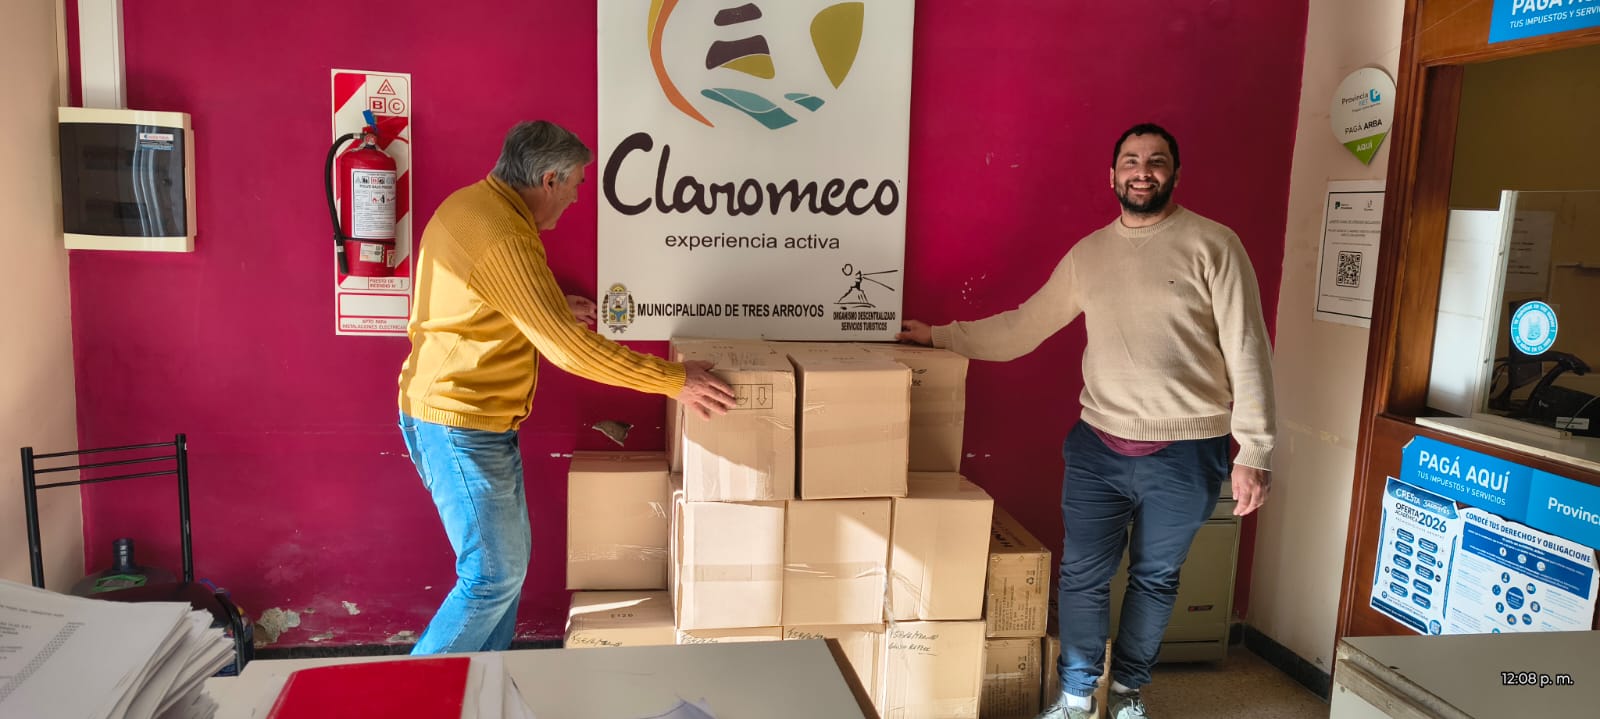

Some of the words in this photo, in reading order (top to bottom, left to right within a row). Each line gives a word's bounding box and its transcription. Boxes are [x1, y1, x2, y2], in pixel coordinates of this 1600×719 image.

[1509, 20, 1524, 29] TUS
[1525, 11, 1568, 27] IMPUESTOS
[1569, 10, 1575, 18] Y
[372, 100, 383, 110] B
[1341, 91, 1369, 105] Provincia
[1363, 118, 1383, 130] ARBA
[602, 132, 900, 216] Claromeco
[665, 233, 778, 251] experiencia
[784, 234, 840, 250] activa
[637, 303, 723, 317] MUNICIPALIDAD
[724, 304, 740, 318] DE
[742, 304, 770, 319] TRES
[771, 304, 824, 320] ARROYOS
[833, 312, 857, 321] ORGANISMO
[858, 312, 896, 321] DESCENTRALIZADO
[841, 322, 863, 331] SERVICIOS
[863, 322, 887, 331] TURISTICOS
[1418, 450, 1461, 478] PAGÁ
[1465, 465, 1511, 494] AQUÍ
[1417, 471, 1429, 481] TUS
[1429, 474, 1465, 492] IMPUESTOS
[1465, 487, 1470, 495] Y
[1471, 488, 1507, 506] SERVICIOS
[1395, 502, 1420, 518] OFERTA
[1418, 512, 1447, 533] 2026
[1465, 511, 1487, 527] CONOCÉ
[1487, 519, 1500, 531] TUS
[1500, 523, 1536, 543] DERECHOS
[1536, 536, 1542, 545] Y
